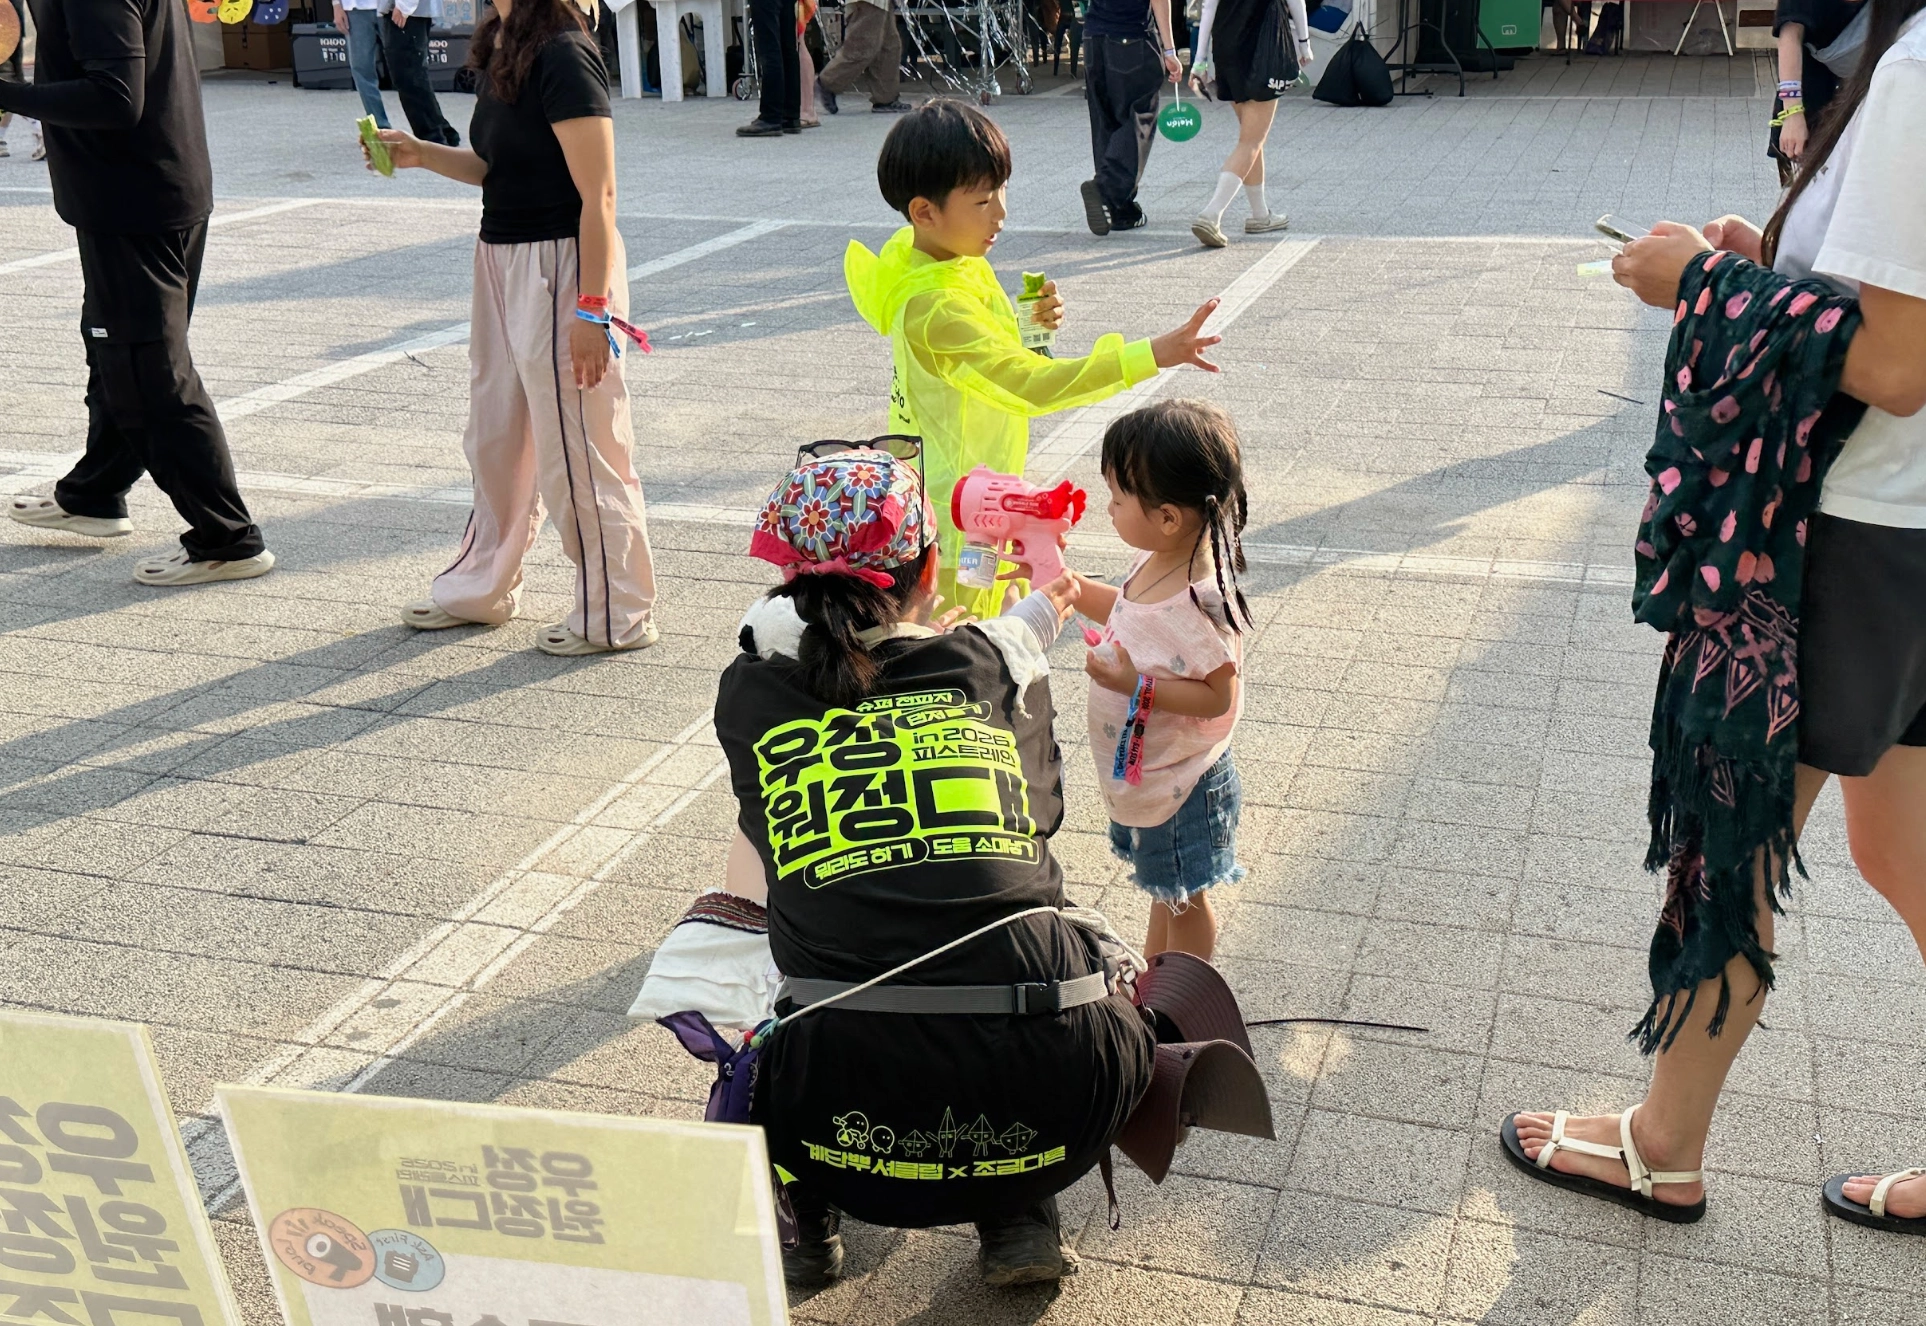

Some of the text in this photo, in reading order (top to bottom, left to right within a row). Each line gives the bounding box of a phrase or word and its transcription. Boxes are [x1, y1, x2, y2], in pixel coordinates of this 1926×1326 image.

[856, 698, 892, 712] 슈퍼
[913, 728, 1010, 747] in 2026
[757, 712, 902, 787] 우정
[912, 745, 1016, 767] 피스트레인
[765, 767, 1033, 867] 원정대
[871, 842, 914, 864] 하기
[933, 837, 972, 854] 도움
